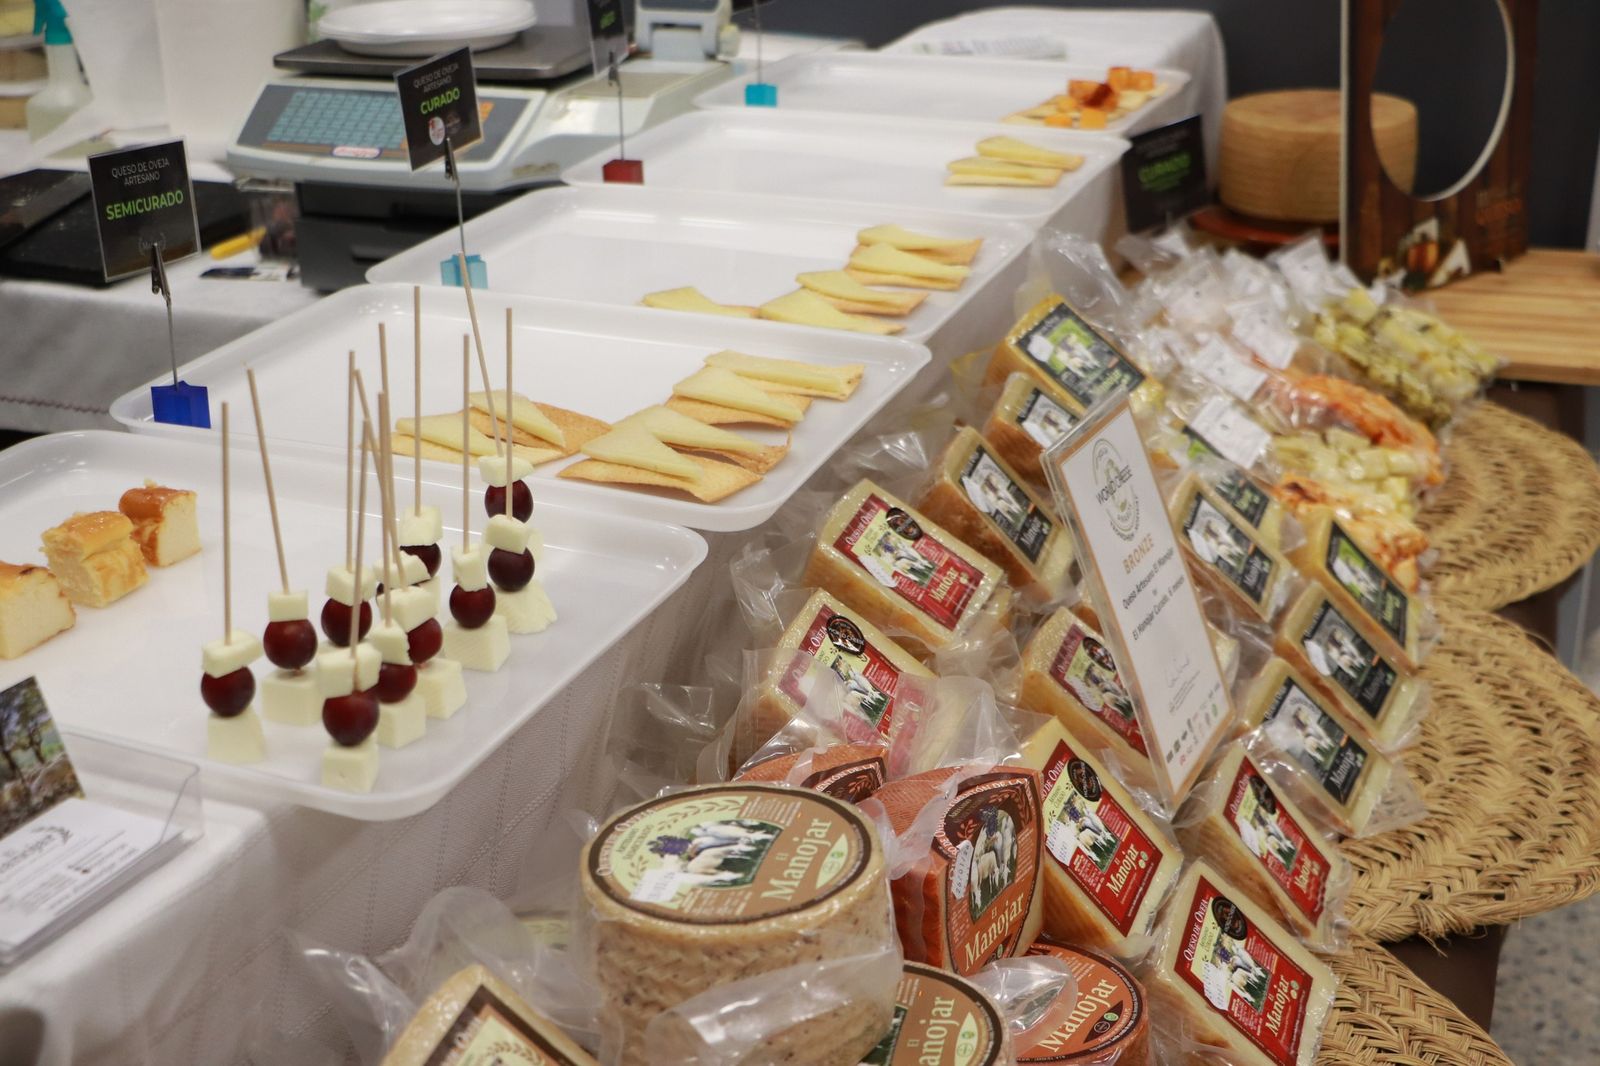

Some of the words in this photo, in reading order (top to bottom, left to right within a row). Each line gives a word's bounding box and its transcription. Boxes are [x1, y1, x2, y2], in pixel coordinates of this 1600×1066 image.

[413, 73, 433, 89] QUESO
[433, 70, 442, 80] DE
[423, 75, 452, 93] ARTESANO
[420, 87, 461, 115] CURADO
[111, 164, 137, 178] QUESO
[137, 160, 148, 172] DE
[148, 158, 170, 170] OVEJA
[124, 171, 160, 186] ARTESANO
[106, 190, 184, 220] SEMICURADO
[1123, 533, 1154, 575] BRONZE
[1123, 590, 1137, 610] Queso
[1135, 570, 1155, 593] Artesano
[810, 625, 828, 648] OVEJA
[1132, 629, 1139, 640] El
[992, 780, 1007, 789] DE
[1008, 778, 1023, 786] LA
[1044, 780, 1052, 792] DE
[1048, 760, 1065, 781] OVEJA
[761, 817, 832, 901] Manojar
[1106, 843, 1140, 897] Manojar
[1194, 899, 1208, 923] OVEJA
[964, 893, 1024, 972] Manojar
[1193, 922, 1201, 934] DE
[1183, 933, 1197, 961] QUESO
[1038, 979, 1118, 1052] Manojar
[1264, 974, 1290, 1037] Manojar
[919, 996, 960, 1066] anojar
